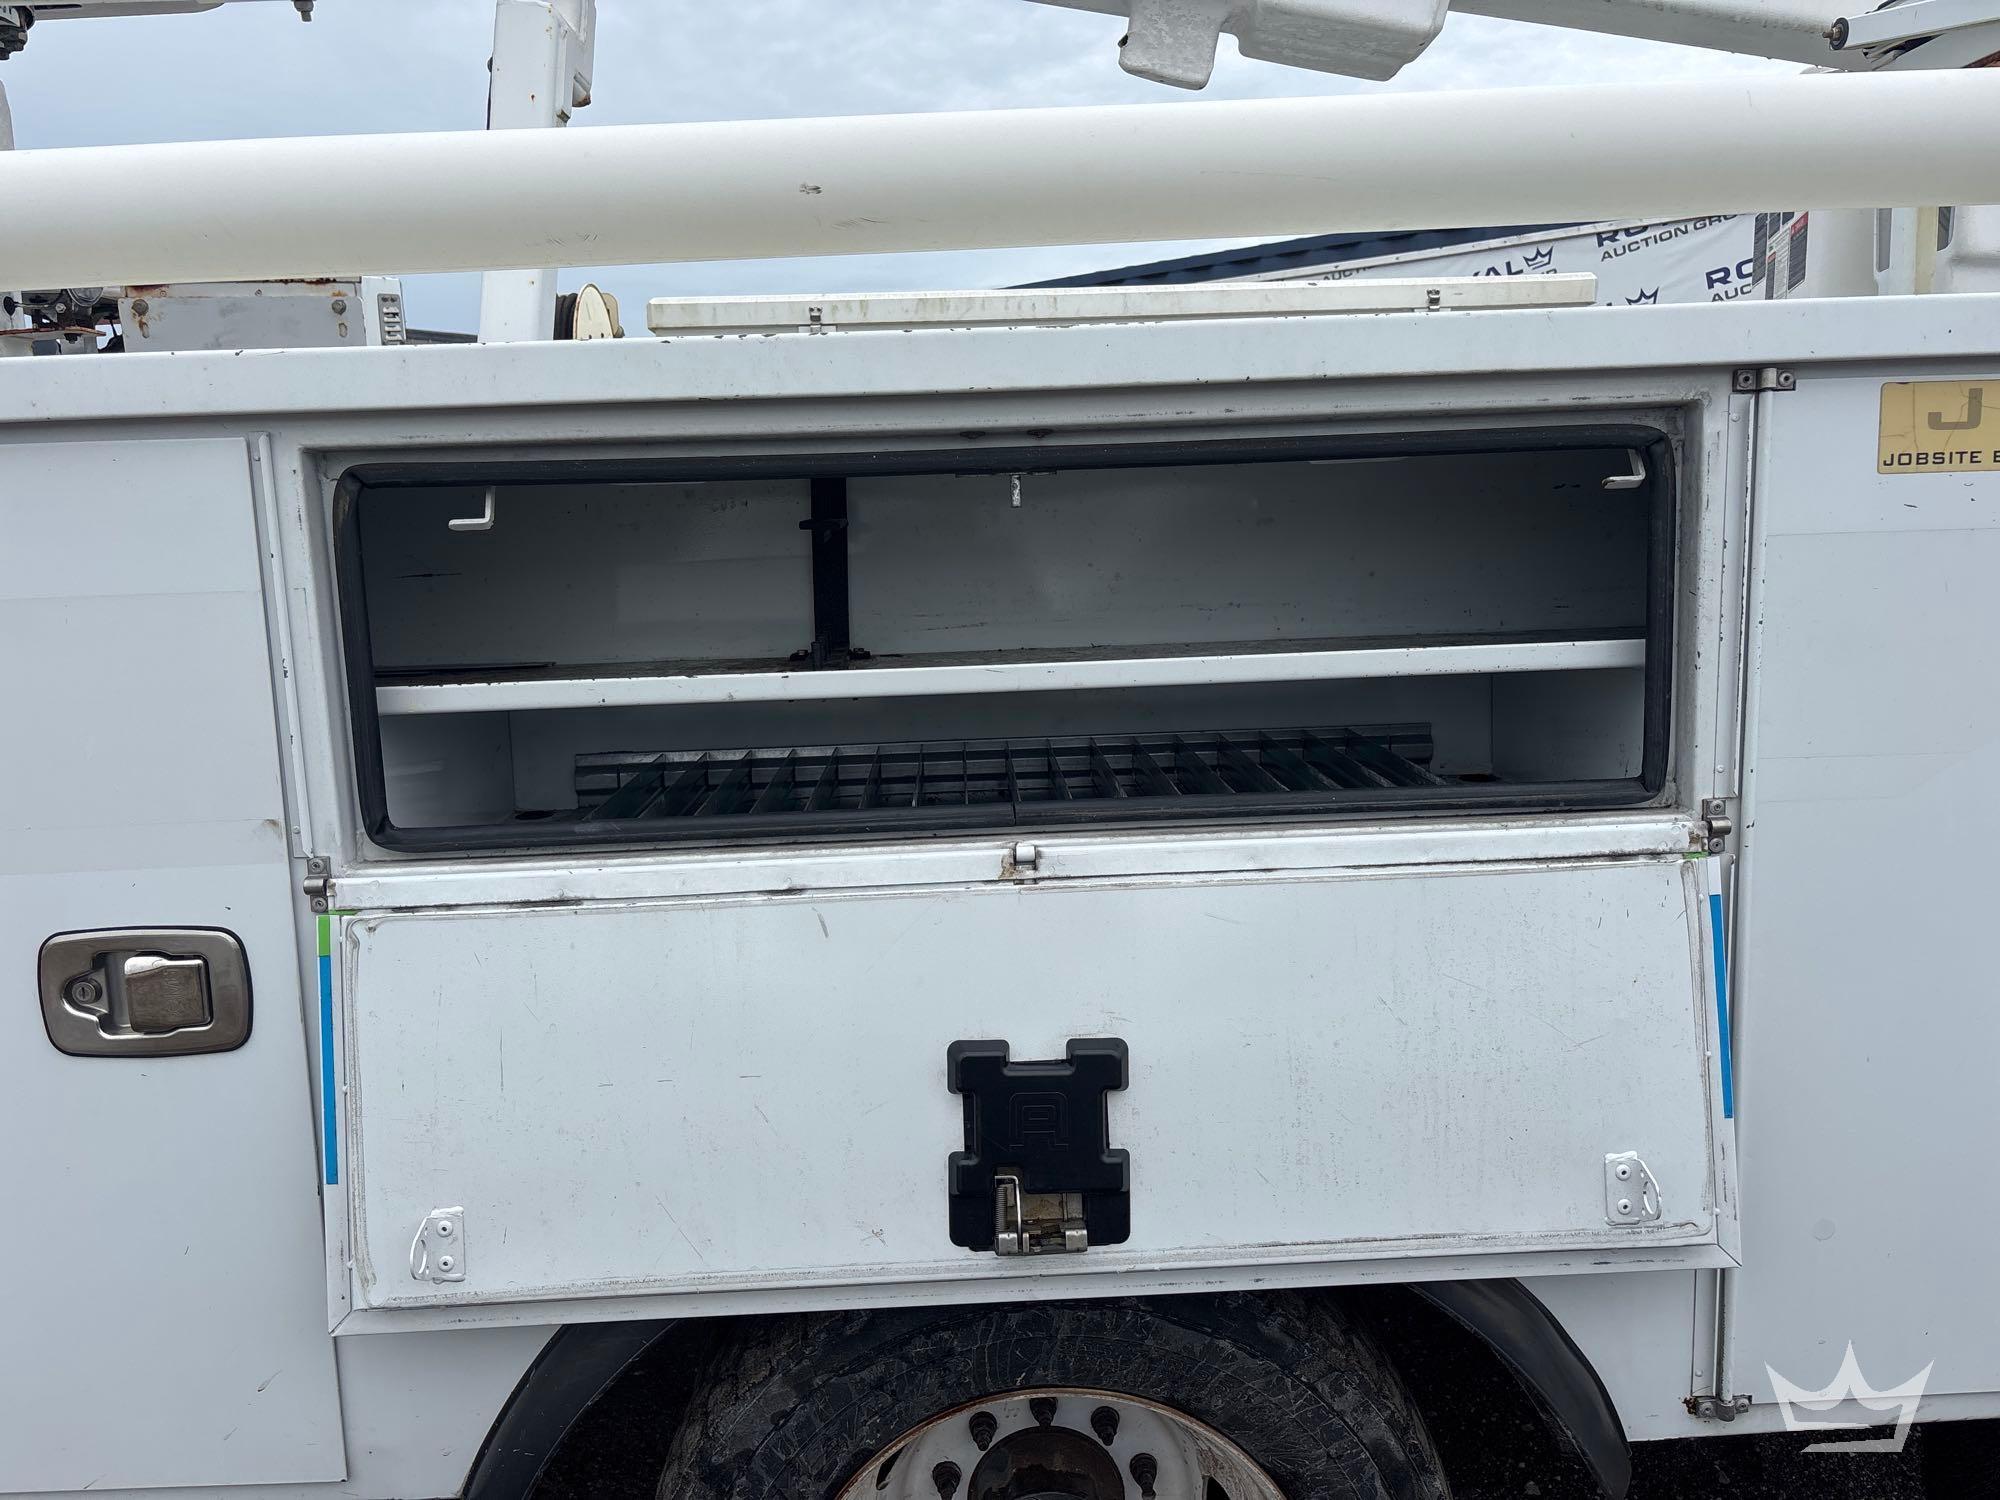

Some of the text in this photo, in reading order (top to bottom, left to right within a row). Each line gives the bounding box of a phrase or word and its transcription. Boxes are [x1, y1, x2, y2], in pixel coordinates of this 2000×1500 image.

[1601, 223, 1689, 262] AUCTION
[1928, 387, 1983, 430] J
[1883, 451, 1982, 466] JOBSITE
